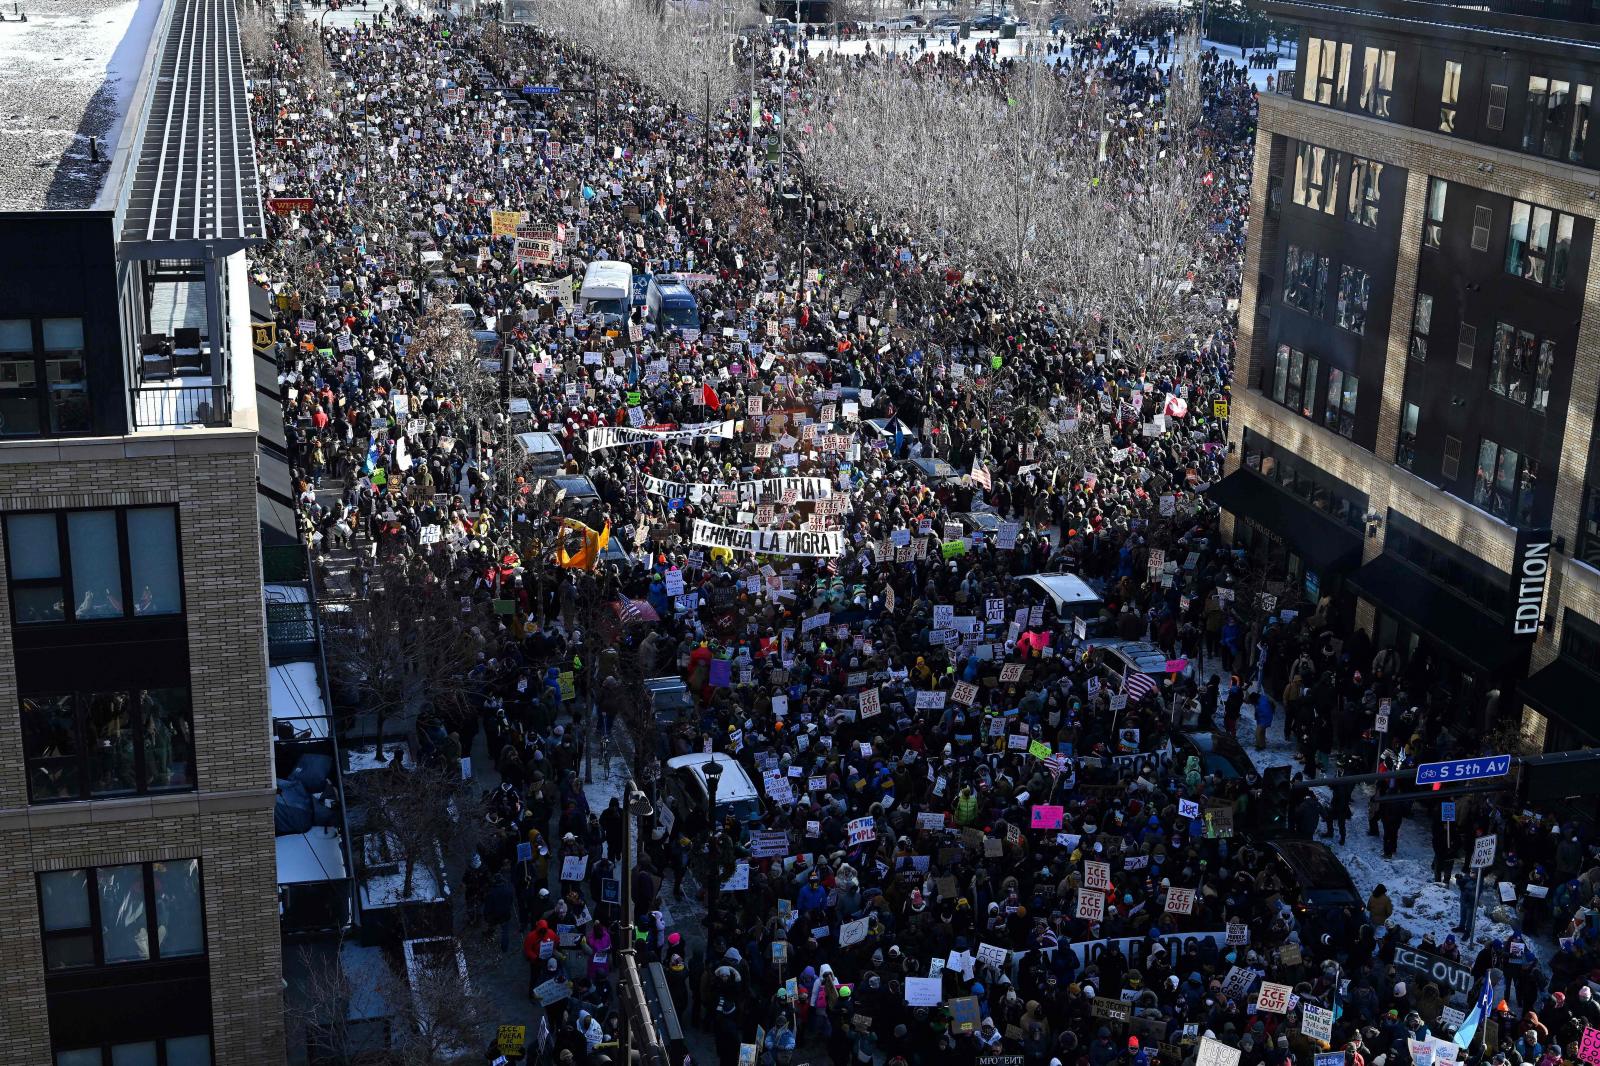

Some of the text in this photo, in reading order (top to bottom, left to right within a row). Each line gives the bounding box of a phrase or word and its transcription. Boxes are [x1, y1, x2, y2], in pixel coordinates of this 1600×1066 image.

[518, 241, 550, 252] KILLER ICE
[606, 427, 659, 446] FUNDING
[656, 483, 695, 504] MORE
[762, 478, 822, 501] MILITIA!
[809, 523, 824, 531] OUT!
[760, 532, 780, 551] LA
[1514, 542, 1551, 635] EDITION
[988, 600, 1003, 610] ICE
[988, 610, 1004, 620] OUT
[944, 629, 958, 638] STOP
[965, 632, 979, 640] STOP
[957, 684, 975, 695] ICE
[862, 695, 877, 705] ICE
[954, 693, 971, 702] OUT!
[862, 704, 879, 713] OUT!
[1439, 760, 1506, 777] S 5th Av
[848, 817, 874, 831] WE THE
[1476, 838, 1494, 848] BEGIN
[1477, 848, 1493, 856] ONE
[1475, 857, 1491, 865] WAY
[1087, 867, 1105, 876] ICE
[1086, 876, 1108, 886] OUT!
[1080, 896, 1101, 907] ICE
[1169, 894, 1189, 903] ICE
[1079, 906, 1102, 919] OUT!
[1167, 902, 1190, 912] OUT!
[980, 946, 1004, 959] ICE
[1235, 967, 1253, 979] ICE
[1394, 947, 1472, 990] ICE OUT
[1231, 974, 1249, 987] OUT
[1228, 982, 1244, 993] FOR
[1263, 990, 1285, 1000] ICE
[1093, 999, 1104, 1007] NO
[1260, 998, 1285, 1009] OUT!
[1304, 1003, 1320, 1014] ICE
[1583, 1036, 1600, 1050] OU
[1582, 1047, 1600, 1057] FO
[1579, 1053, 1600, 1066] GOO
